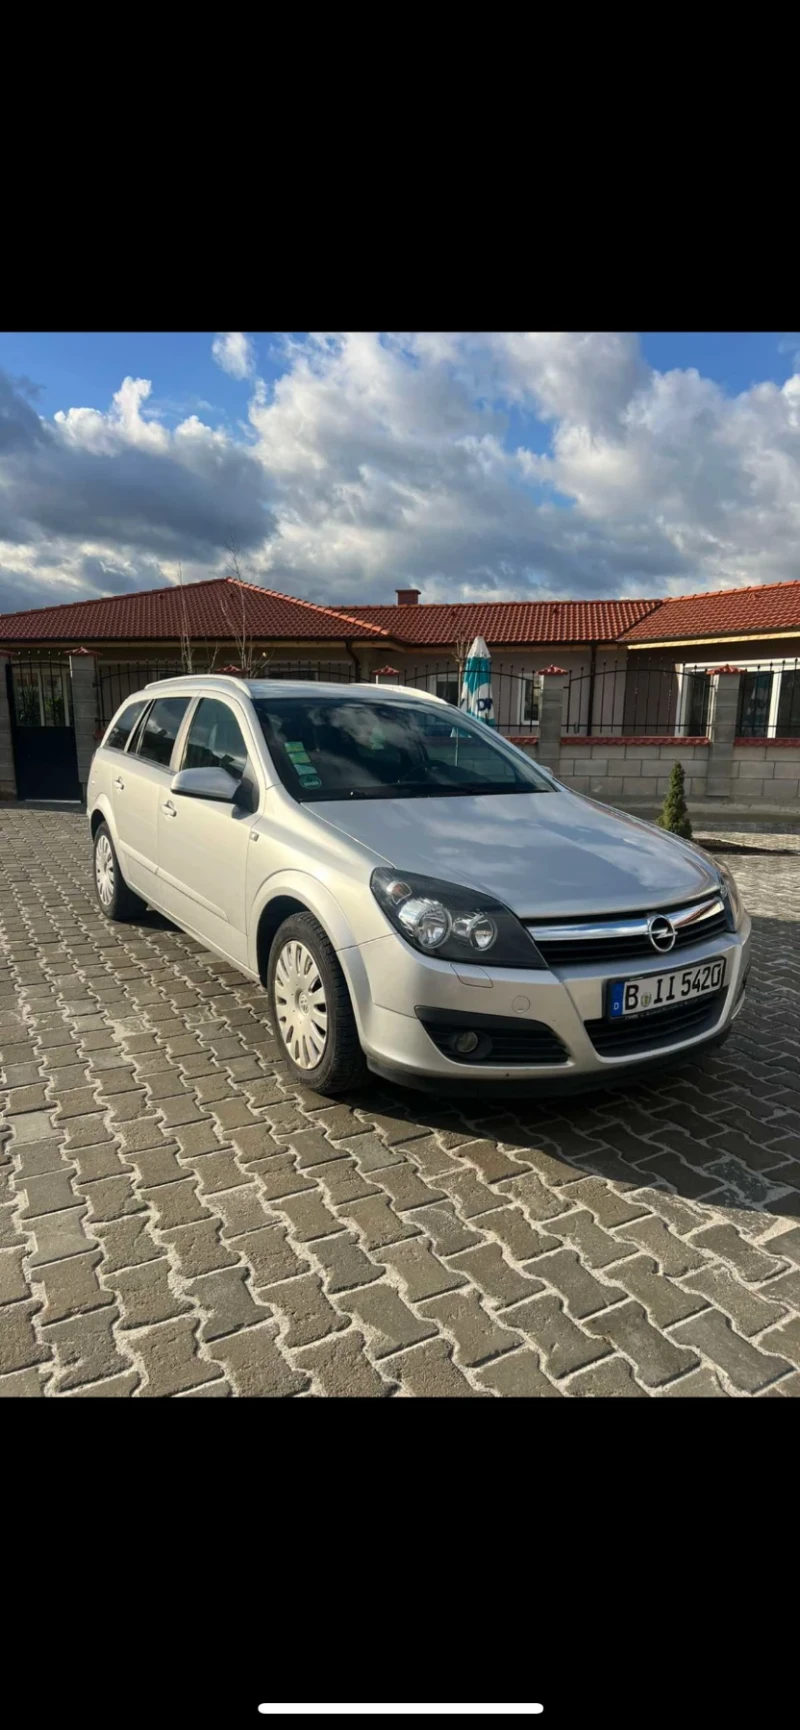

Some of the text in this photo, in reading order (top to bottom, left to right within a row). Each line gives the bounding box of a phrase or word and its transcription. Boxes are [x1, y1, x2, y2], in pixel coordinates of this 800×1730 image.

[624, 984, 639, 1011] B
[681, 963, 721, 996] 5420
[613, 1002, 619, 1010] D
